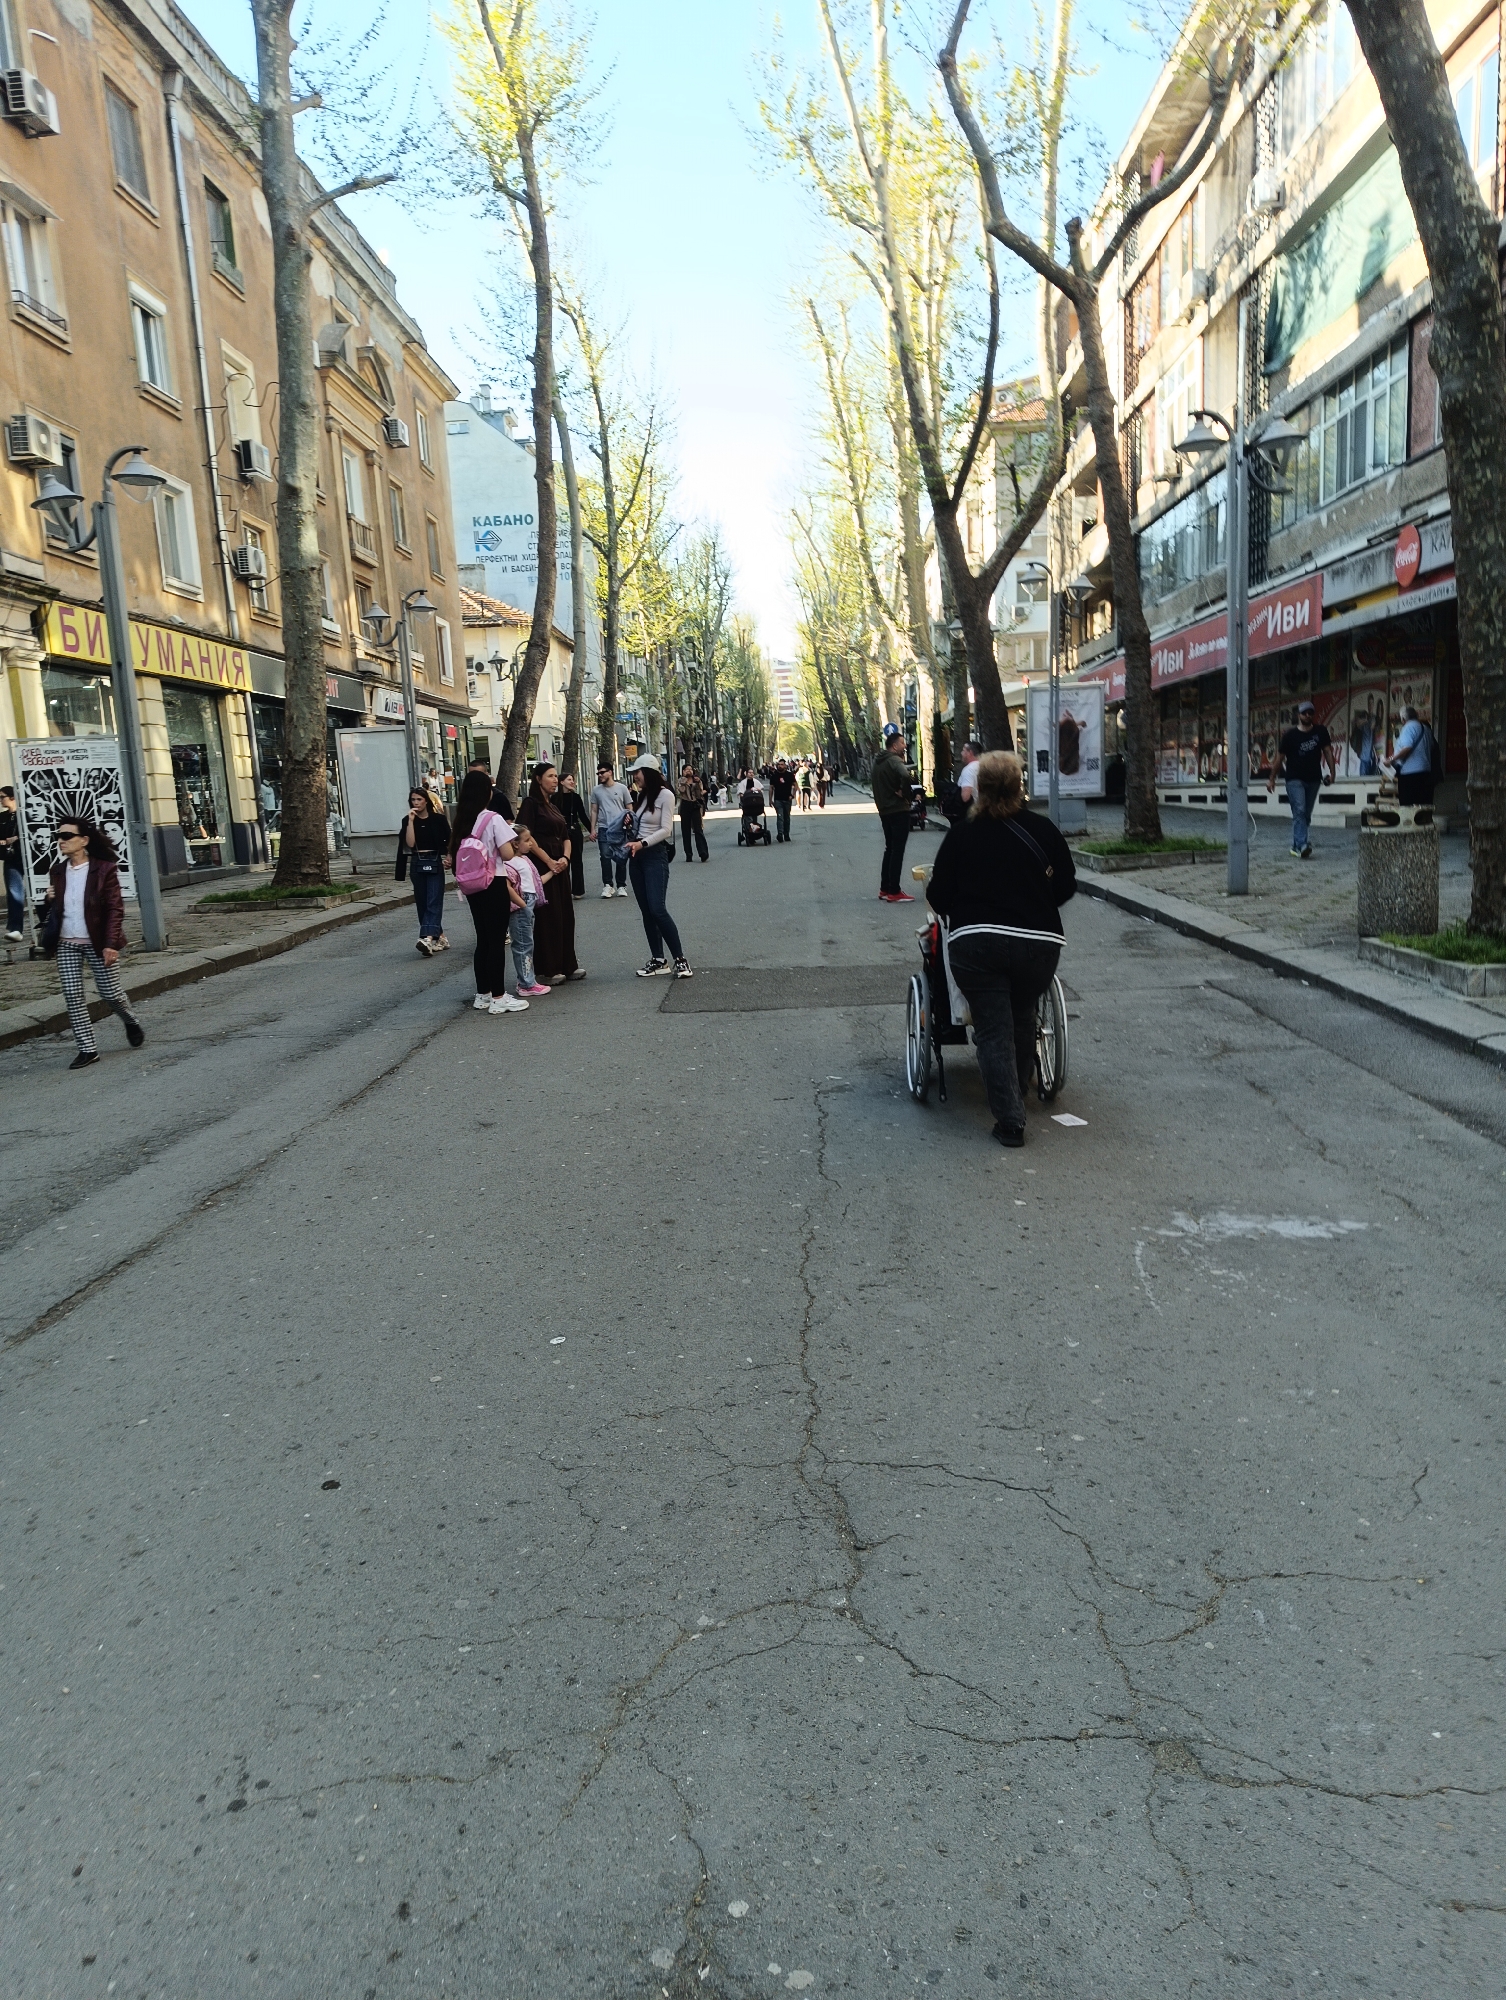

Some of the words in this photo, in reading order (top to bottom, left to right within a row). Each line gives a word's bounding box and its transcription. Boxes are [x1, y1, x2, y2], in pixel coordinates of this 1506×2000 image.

[472, 513, 534, 527] КАБАНО
[476, 554, 518, 563] ПЕРФЕКТНИ
[58, 605, 246, 688] БИУМАНИЯ
